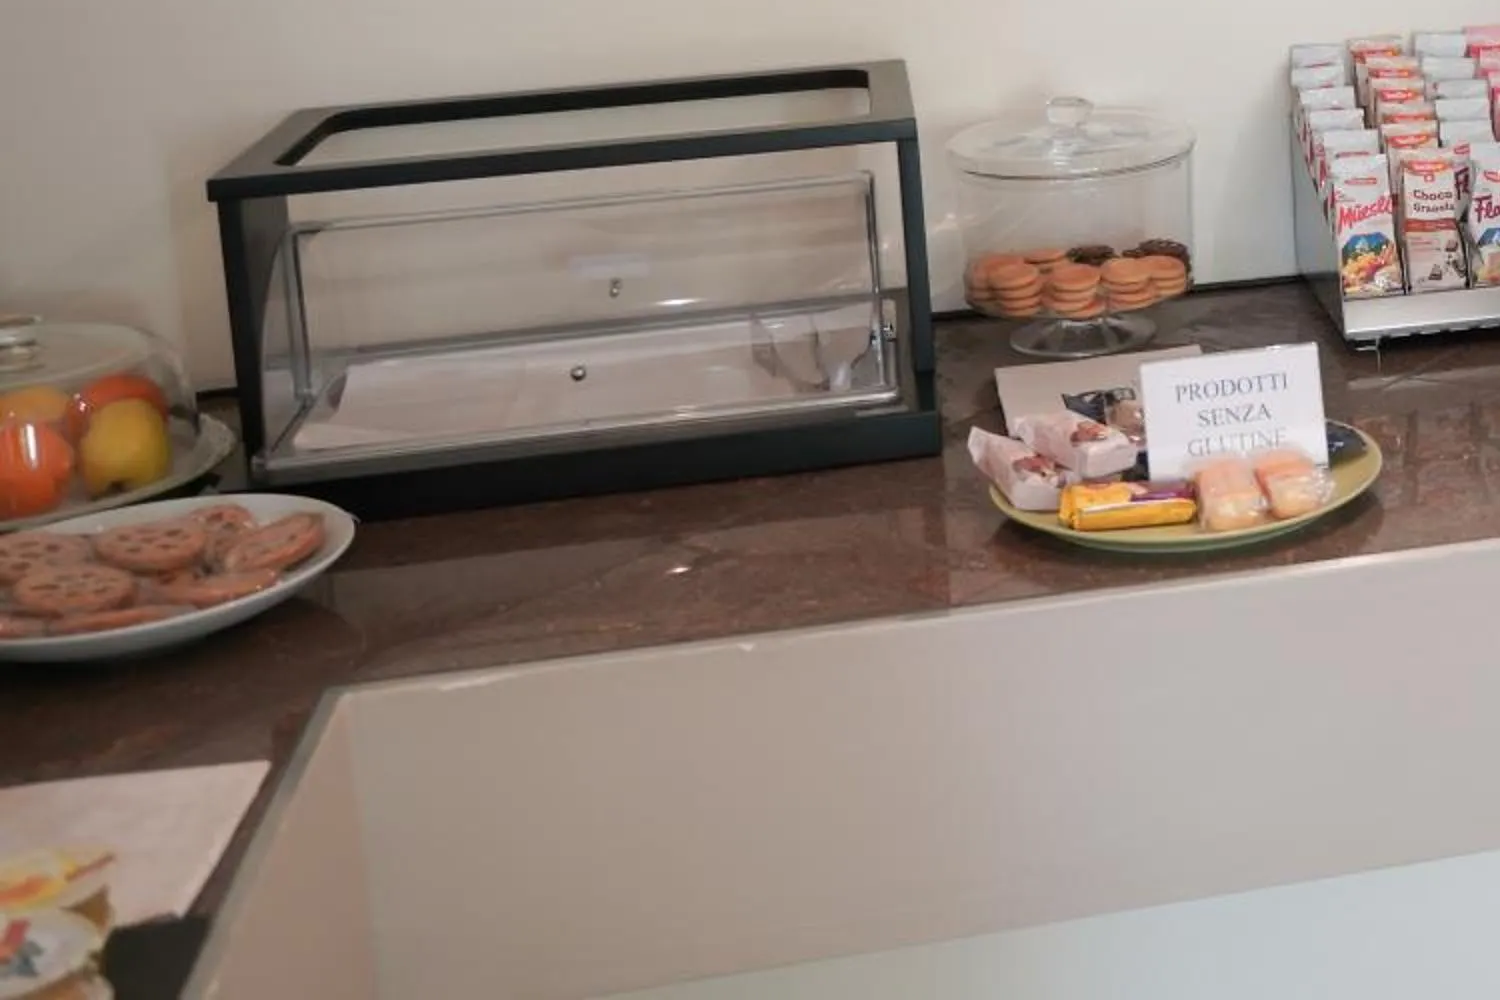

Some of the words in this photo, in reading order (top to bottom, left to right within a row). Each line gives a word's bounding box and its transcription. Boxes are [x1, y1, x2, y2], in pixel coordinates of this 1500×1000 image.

[1413, 188, 1454, 200] Choco
[1175, 373, 1287, 403] PRODOTTI
[1197, 403, 1272, 428] SENZA
[1187, 427, 1287, 458] GLUTINE
